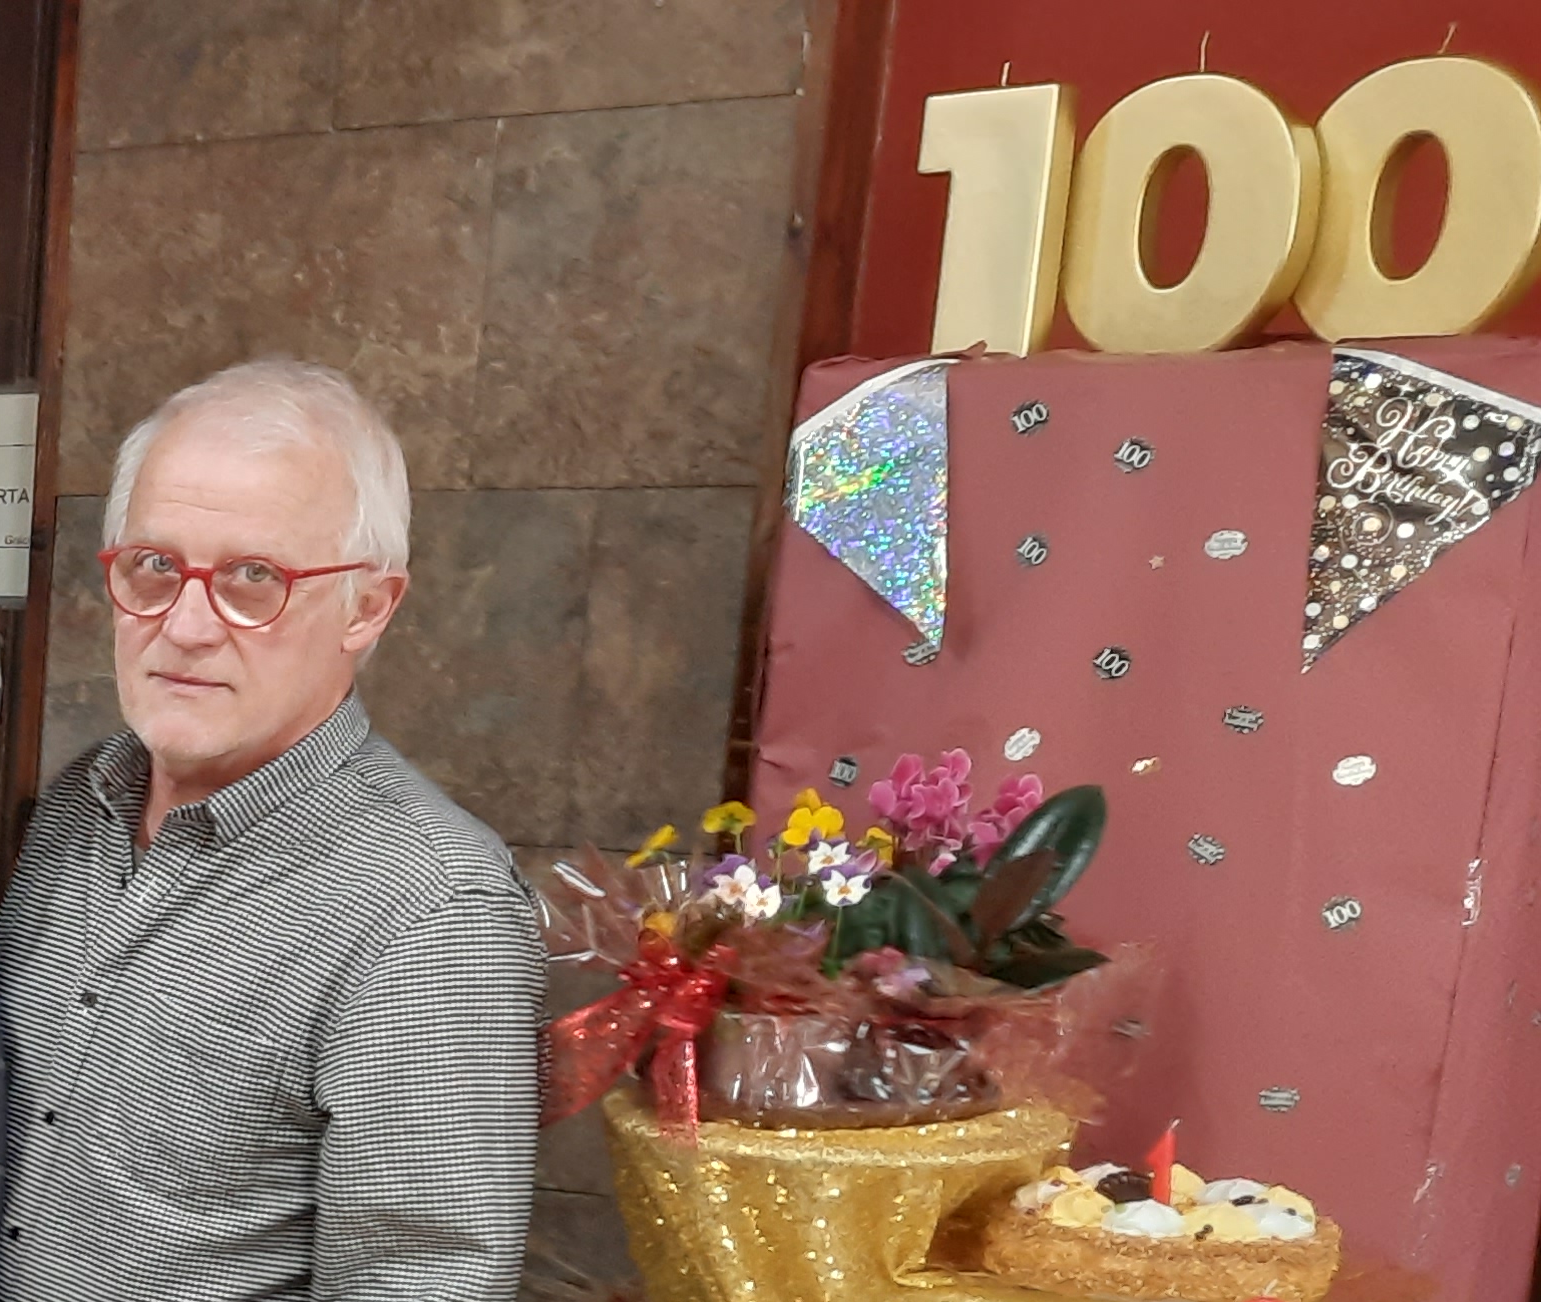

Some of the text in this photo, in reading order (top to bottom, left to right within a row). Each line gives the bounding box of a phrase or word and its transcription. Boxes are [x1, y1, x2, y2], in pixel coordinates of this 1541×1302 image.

[918, 55, 1541, 360] 100
[1011, 403, 1048, 434] 100
[1114, 441, 1153, 470] 100
[1017, 536, 1048, 566] 100
[1093, 647, 1130, 678] 100
[1322, 899, 1362, 930] 100
